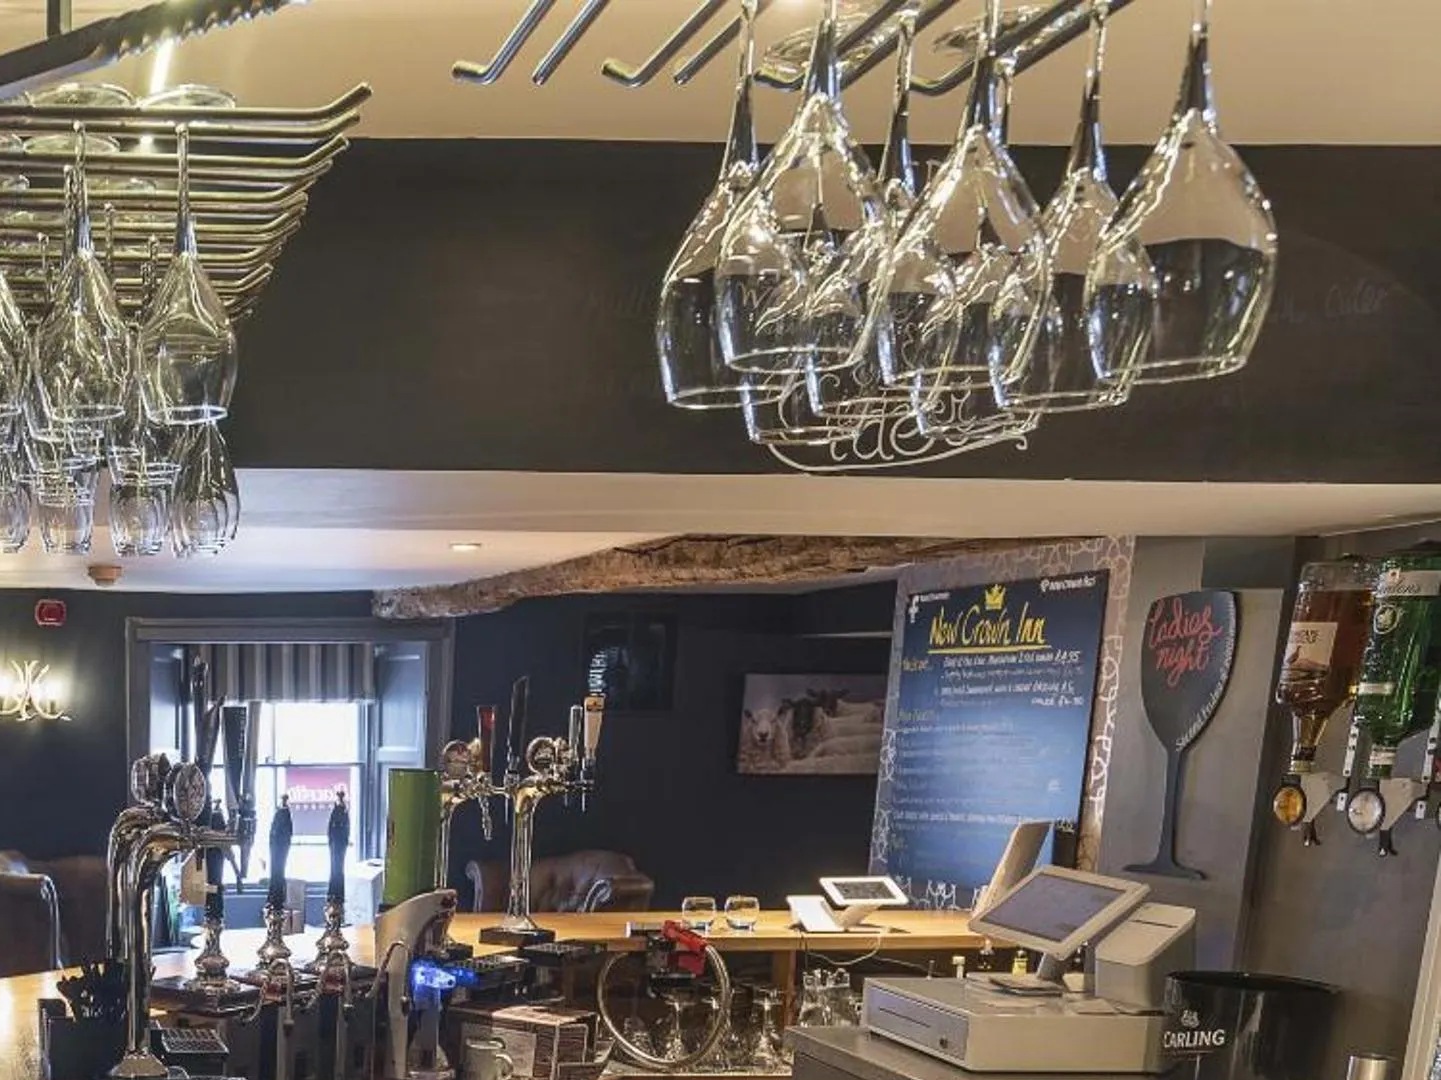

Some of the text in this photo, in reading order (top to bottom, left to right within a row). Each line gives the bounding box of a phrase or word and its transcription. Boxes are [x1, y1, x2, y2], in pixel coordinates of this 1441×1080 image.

[929, 601, 1046, 645] New Crown Inn
[1163, 1028, 1226, 1049] CARLING
